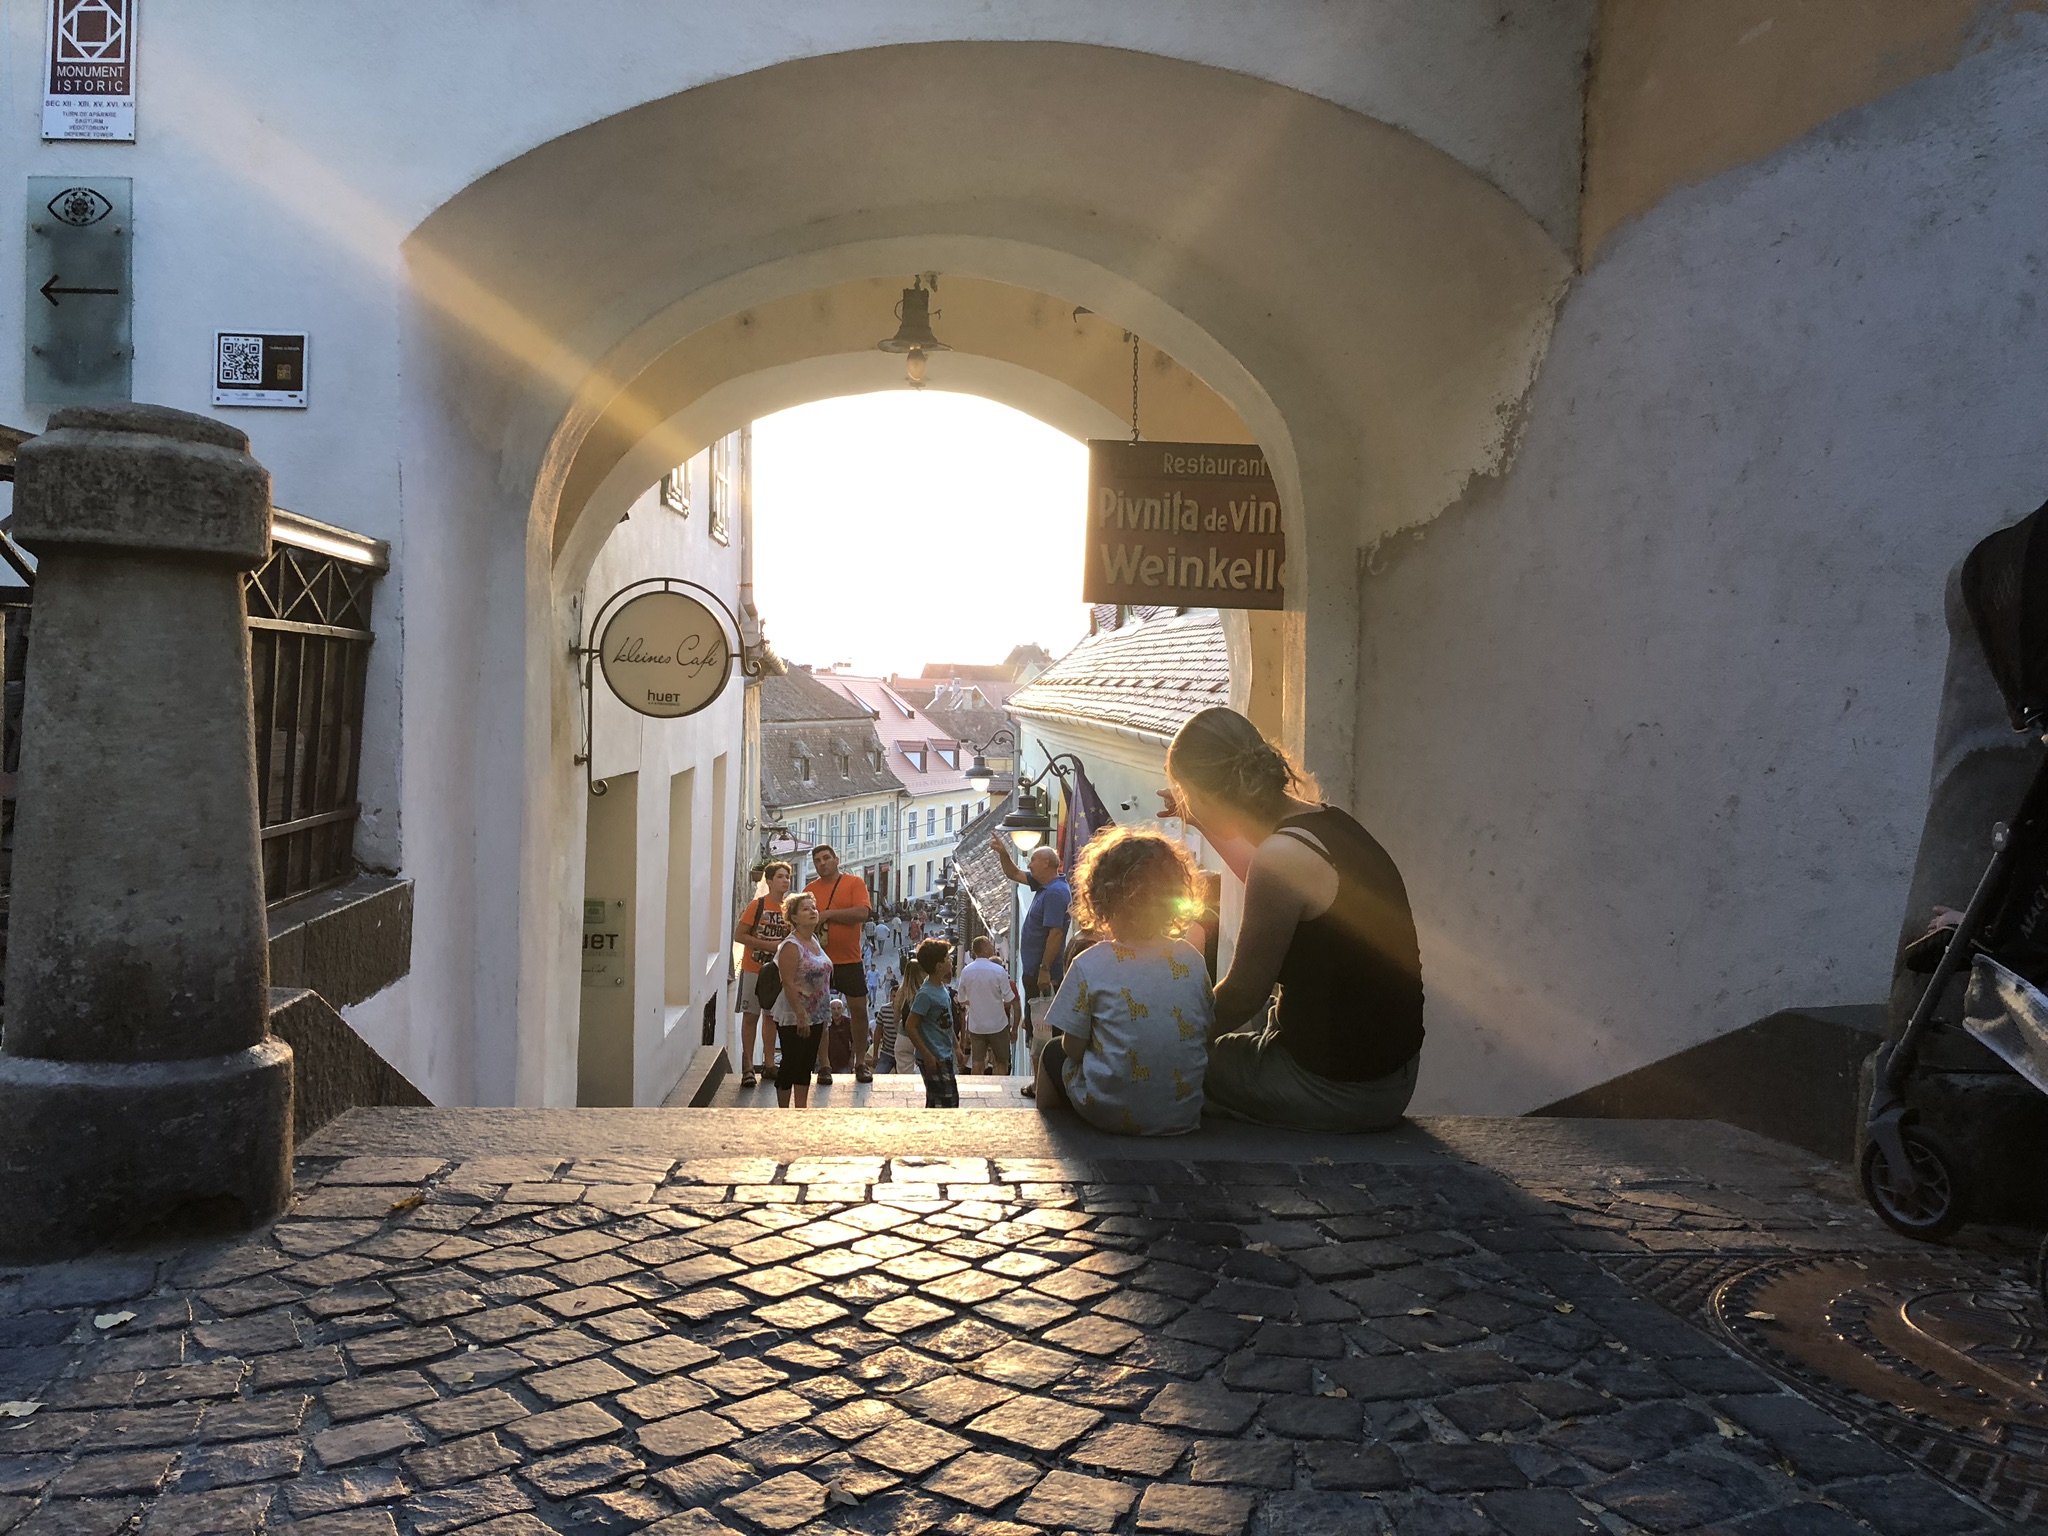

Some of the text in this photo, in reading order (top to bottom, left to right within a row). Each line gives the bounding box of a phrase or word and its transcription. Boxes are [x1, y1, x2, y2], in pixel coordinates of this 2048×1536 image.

[56, 65, 125, 78] MONUMENT
[57, 79, 123, 92] ISTORIC
[1163, 452, 1268, 477] Restaurant
[1204, 507, 1228, 532] de
[612, 634, 721, 679] kleines Café
